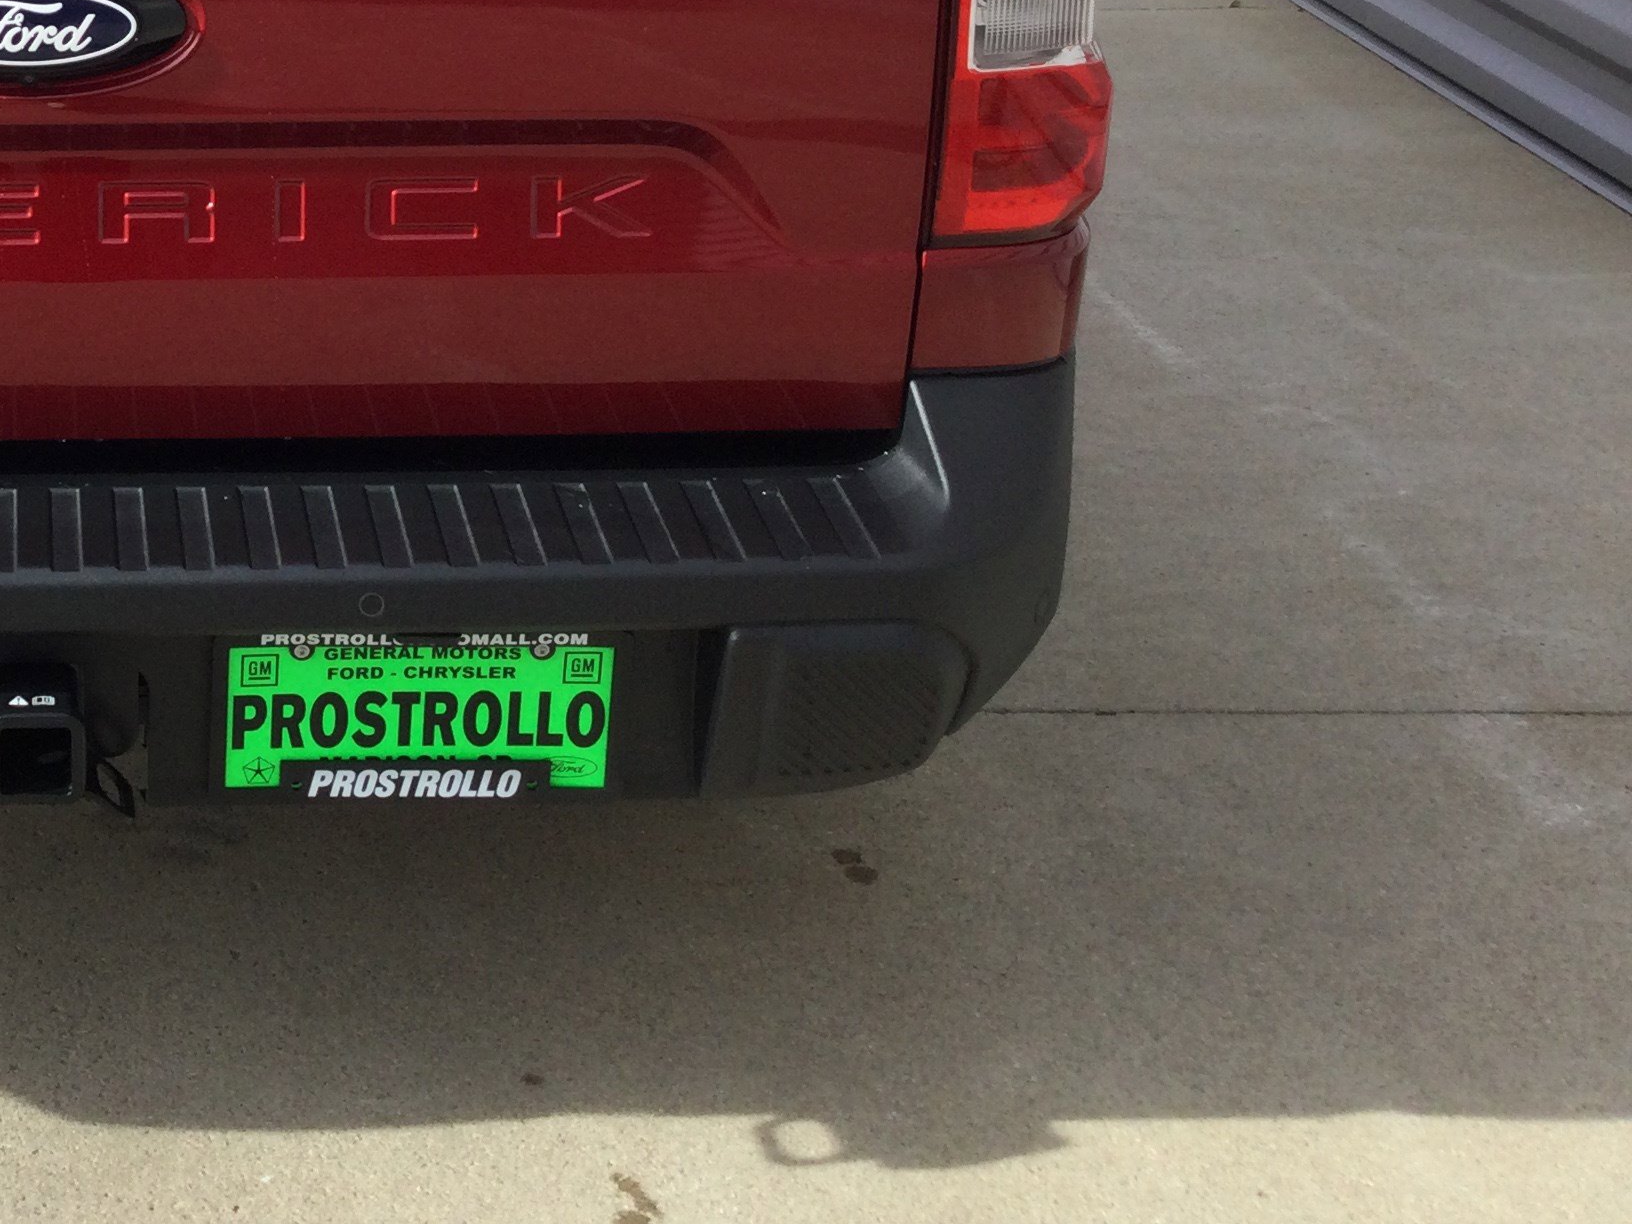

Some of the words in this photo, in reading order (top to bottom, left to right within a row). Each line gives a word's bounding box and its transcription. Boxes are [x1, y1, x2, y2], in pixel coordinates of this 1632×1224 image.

[324, 646, 424, 661] GENERAL
[431, 646, 521, 661] MOTORS
[248, 660, 272, 676] GM
[327, 666, 385, 680] FORD
[403, 665, 516, 680] CHRYSLER
[571, 657, 595, 674] GM
[231, 690, 606, 750] PROSTROLLO
[307, 769, 522, 799] PROSTROLLO
